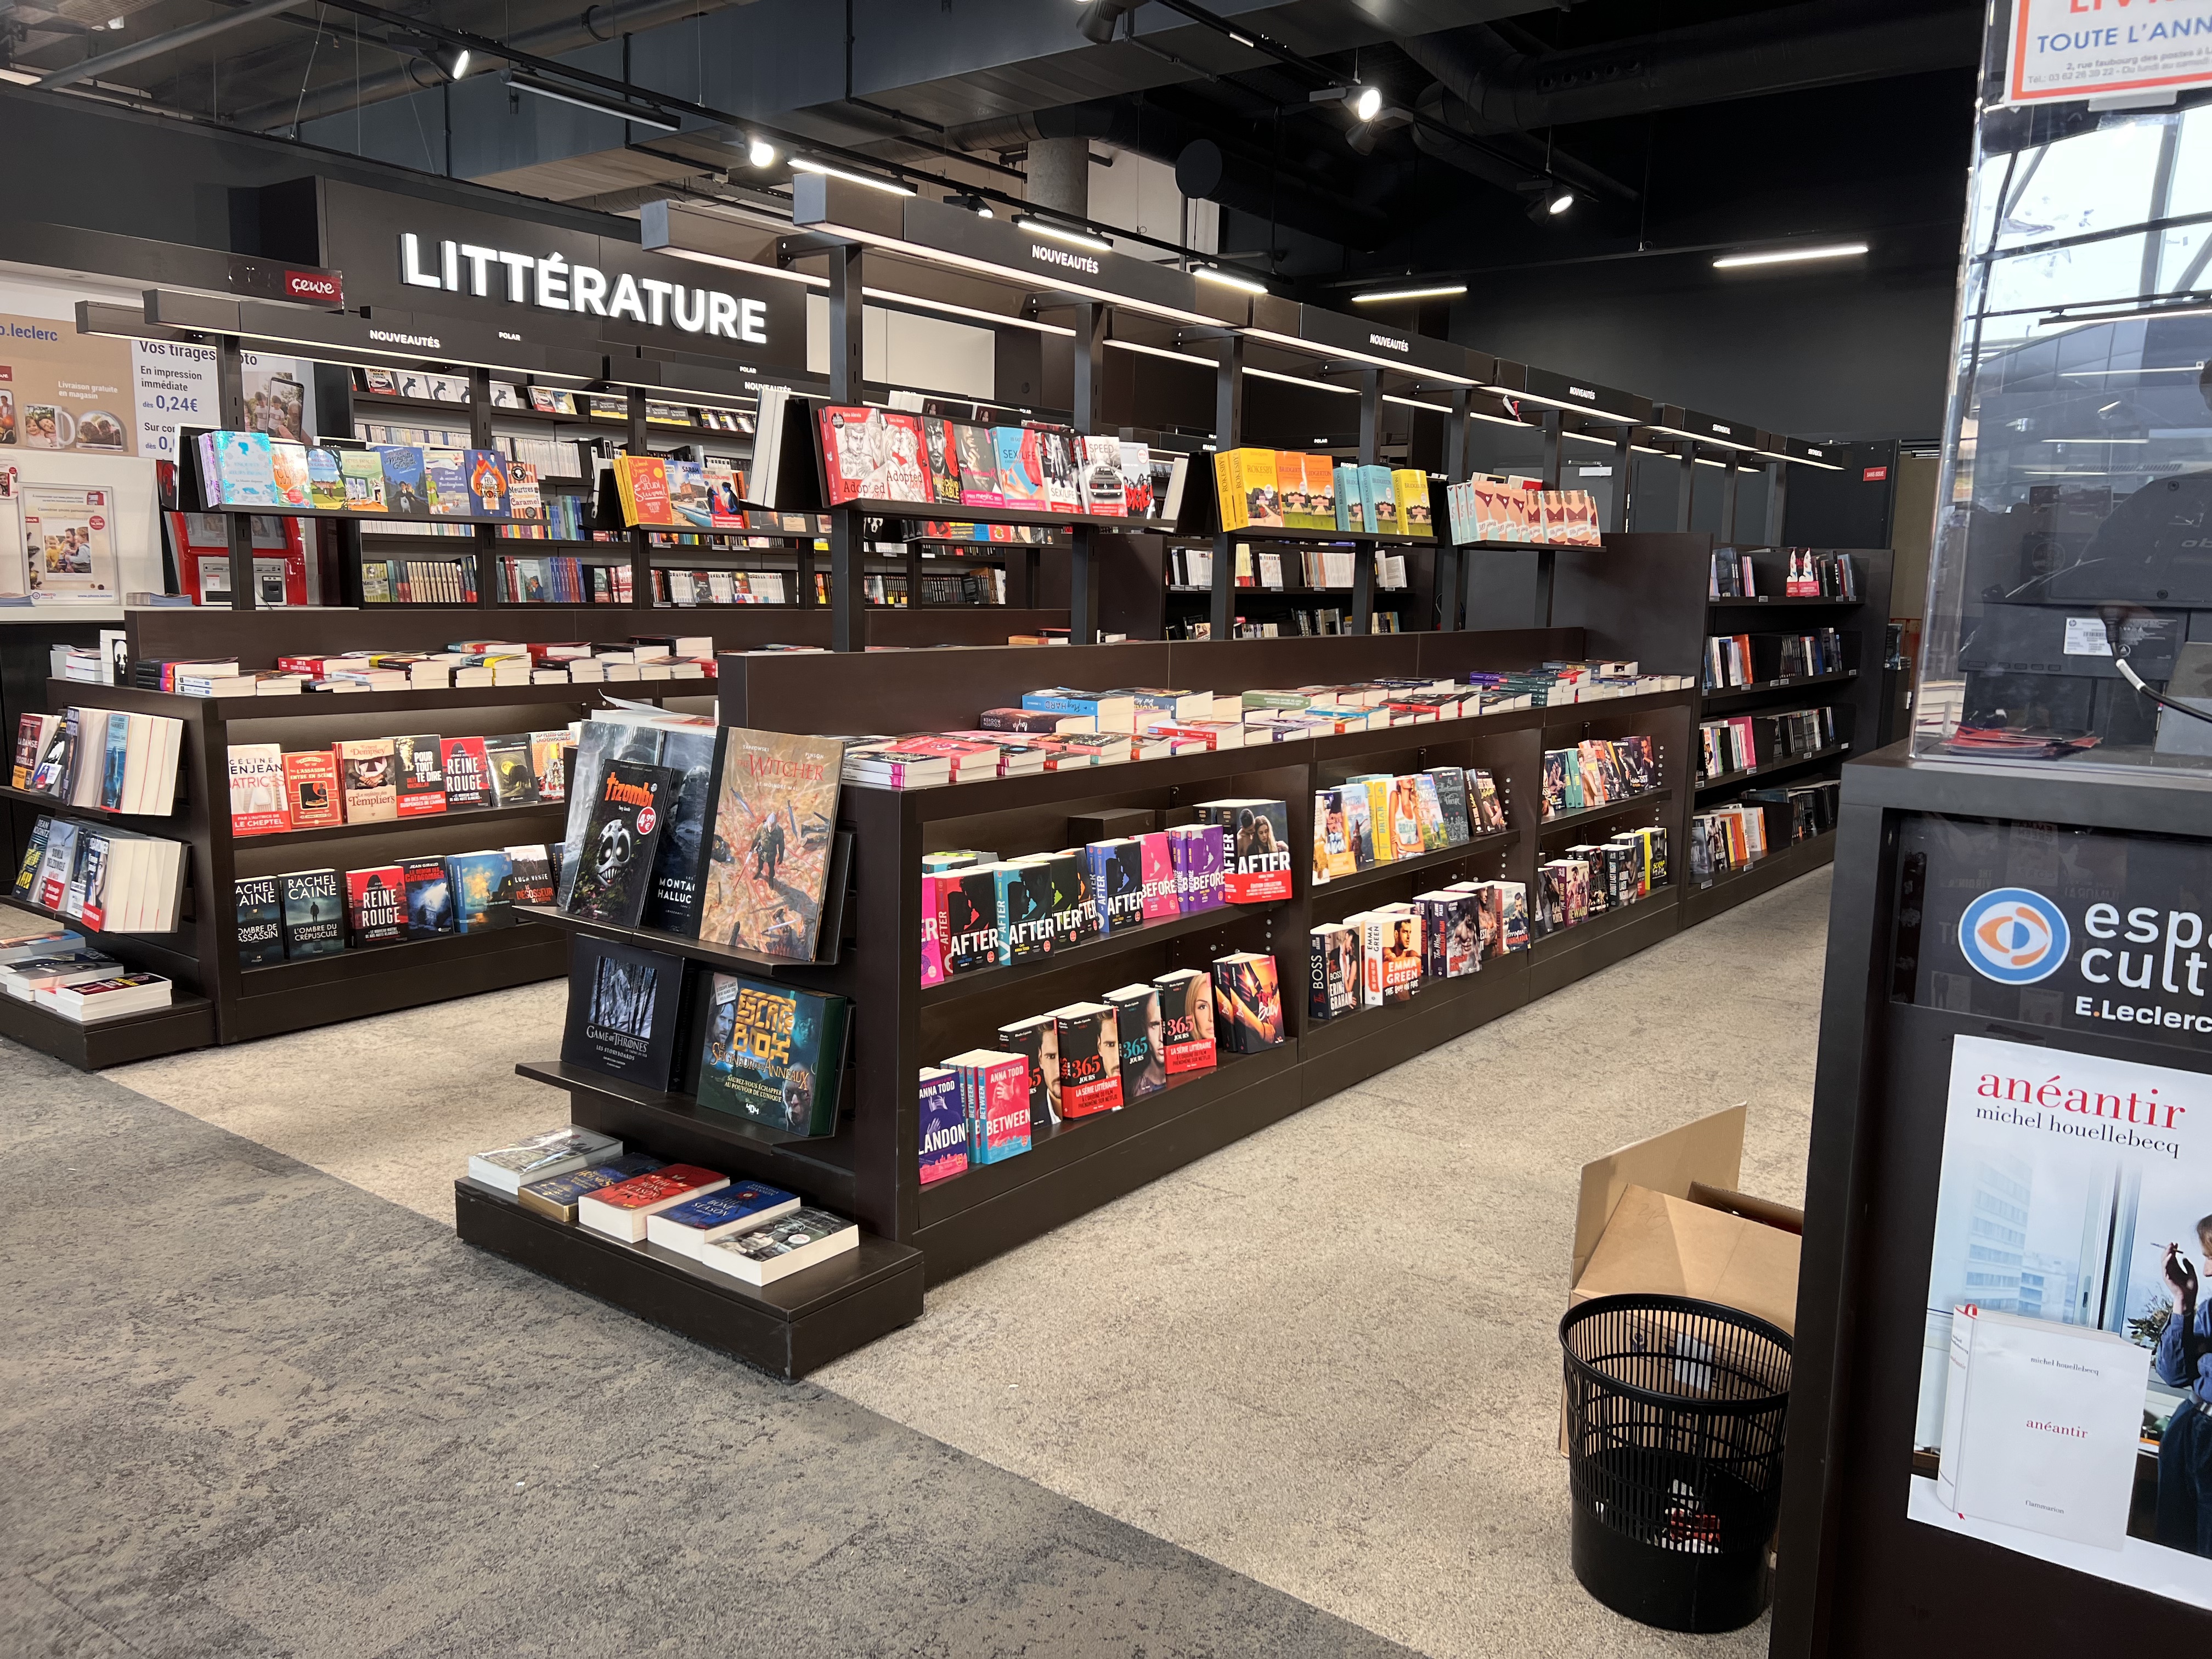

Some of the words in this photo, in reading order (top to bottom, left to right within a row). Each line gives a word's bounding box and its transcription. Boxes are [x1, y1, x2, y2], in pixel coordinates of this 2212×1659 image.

[2038, 27, 2118, 53] TOUTE
[1032, 245, 1099, 273] NOUVEAUTÉS
[400, 233, 767, 345] LITTÉRATURE
[369, 329, 441, 349] NOUVEAUTÉS
[499, 331, 521, 341] POLAR
[1369, 332, 1409, 353] NOUVEAUTÉS
[139, 341, 165, 354] Vos
[170, 343, 216, 362] tirages
[141, 366, 151, 375] En
[154, 366, 202, 380] impression
[740, 366, 757, 374] POLAR
[58, 380, 90, 390] Livraison
[92, 385, 118, 393] gratuite
[142, 380, 188, 392] immédiate
[156, 395, 198, 412] 0,24€
[144, 422, 160, 432] Sur
[1089, 443, 1114, 454] SPEED
[1247, 465, 1272, 474] ROKESBY
[511, 498, 539, 506] Caramel
[350, 746, 388, 755] Dempsey
[414, 751, 433, 763] POUR
[415, 761, 433, 772] TOUT
[447, 757, 478, 775] REINE
[749, 754, 825, 782] WITCHER
[415, 772, 425, 782] TE
[426, 770, 442, 782] DIRE
[446, 774, 482, 792] ROUGE
[348, 795, 395, 807] Templiers
[1238, 851, 1290, 874] AFTER
[288, 874, 336, 889] RACHEL
[1142, 879, 1176, 899] BEFORE
[289, 884, 337, 900] CAINE
[363, 889, 397, 909] REINE
[657, 889, 692, 904] HALLUC
[1107, 890, 1143, 917] AFTER
[362, 906, 401, 927] ROUGE
[294, 925, 325, 934] L'OMBRE
[295, 929, 337, 941] CRÉPUSCULE
[1009, 917, 1054, 945] AFTER
[951, 928, 999, 956] AFTER
[1311, 955, 1323, 989] BOSS
[1389, 959, 1417, 973] EMMA
[1330, 970, 1342, 981] BOSS
[1386, 968, 1418, 984] GREEN
[1330, 982, 1344, 996] ERIN
[1330, 991, 1353, 1011] GRAHAM
[2075, 995, 2212, 1033] E.Leclerc
[1167, 1015, 1194, 1036] 365
[586, 1025, 609, 1042] GAME
[613, 1032, 649, 1052] THRONES
[733, 1023, 791, 1064] BOX
[1173, 1032, 1189, 1041] JOURS
[604, 1047, 635, 1060] STORYBOARDS
[1124, 1036, 1148, 1059] 365
[1189, 1041, 1211, 1052] LITTÉRAIRE
[1072, 1055, 1101, 1079] 365
[1130, 1055, 1144, 1064] JOURS
[763, 1059, 809, 1091] ANNEAUX
[990, 1070, 1007, 1084] ANNA
[1008, 1065, 1024, 1078] TODD
[1079, 1074, 1095, 1084] JOURS
[731, 1083, 753, 1094] POUVOIR
[919, 1085, 937, 1099] ANNA
[938, 1080, 955, 1092] TODD
[1082, 1086, 1094, 1096] SÉRIE
[1094, 1079, 1118, 1092] LITTÉRAIRE
[1977, 1074, 2186, 1130] anéantir
[986, 1108, 1030, 1137] BETWEEN
[1976, 1105, 2042, 1129] michel
[2049, 1114, 2180, 1159] houellebecq
[691, 1202, 729, 1216] SEASON
[707, 1199, 736, 1210] BONE
[2031, 1356, 2055, 1367] michel
[2057, 1360, 2099, 1376] houellebecq
[2026, 1419, 2088, 1439] anéantir
[2025, 1499, 2064, 1514] flammarion
